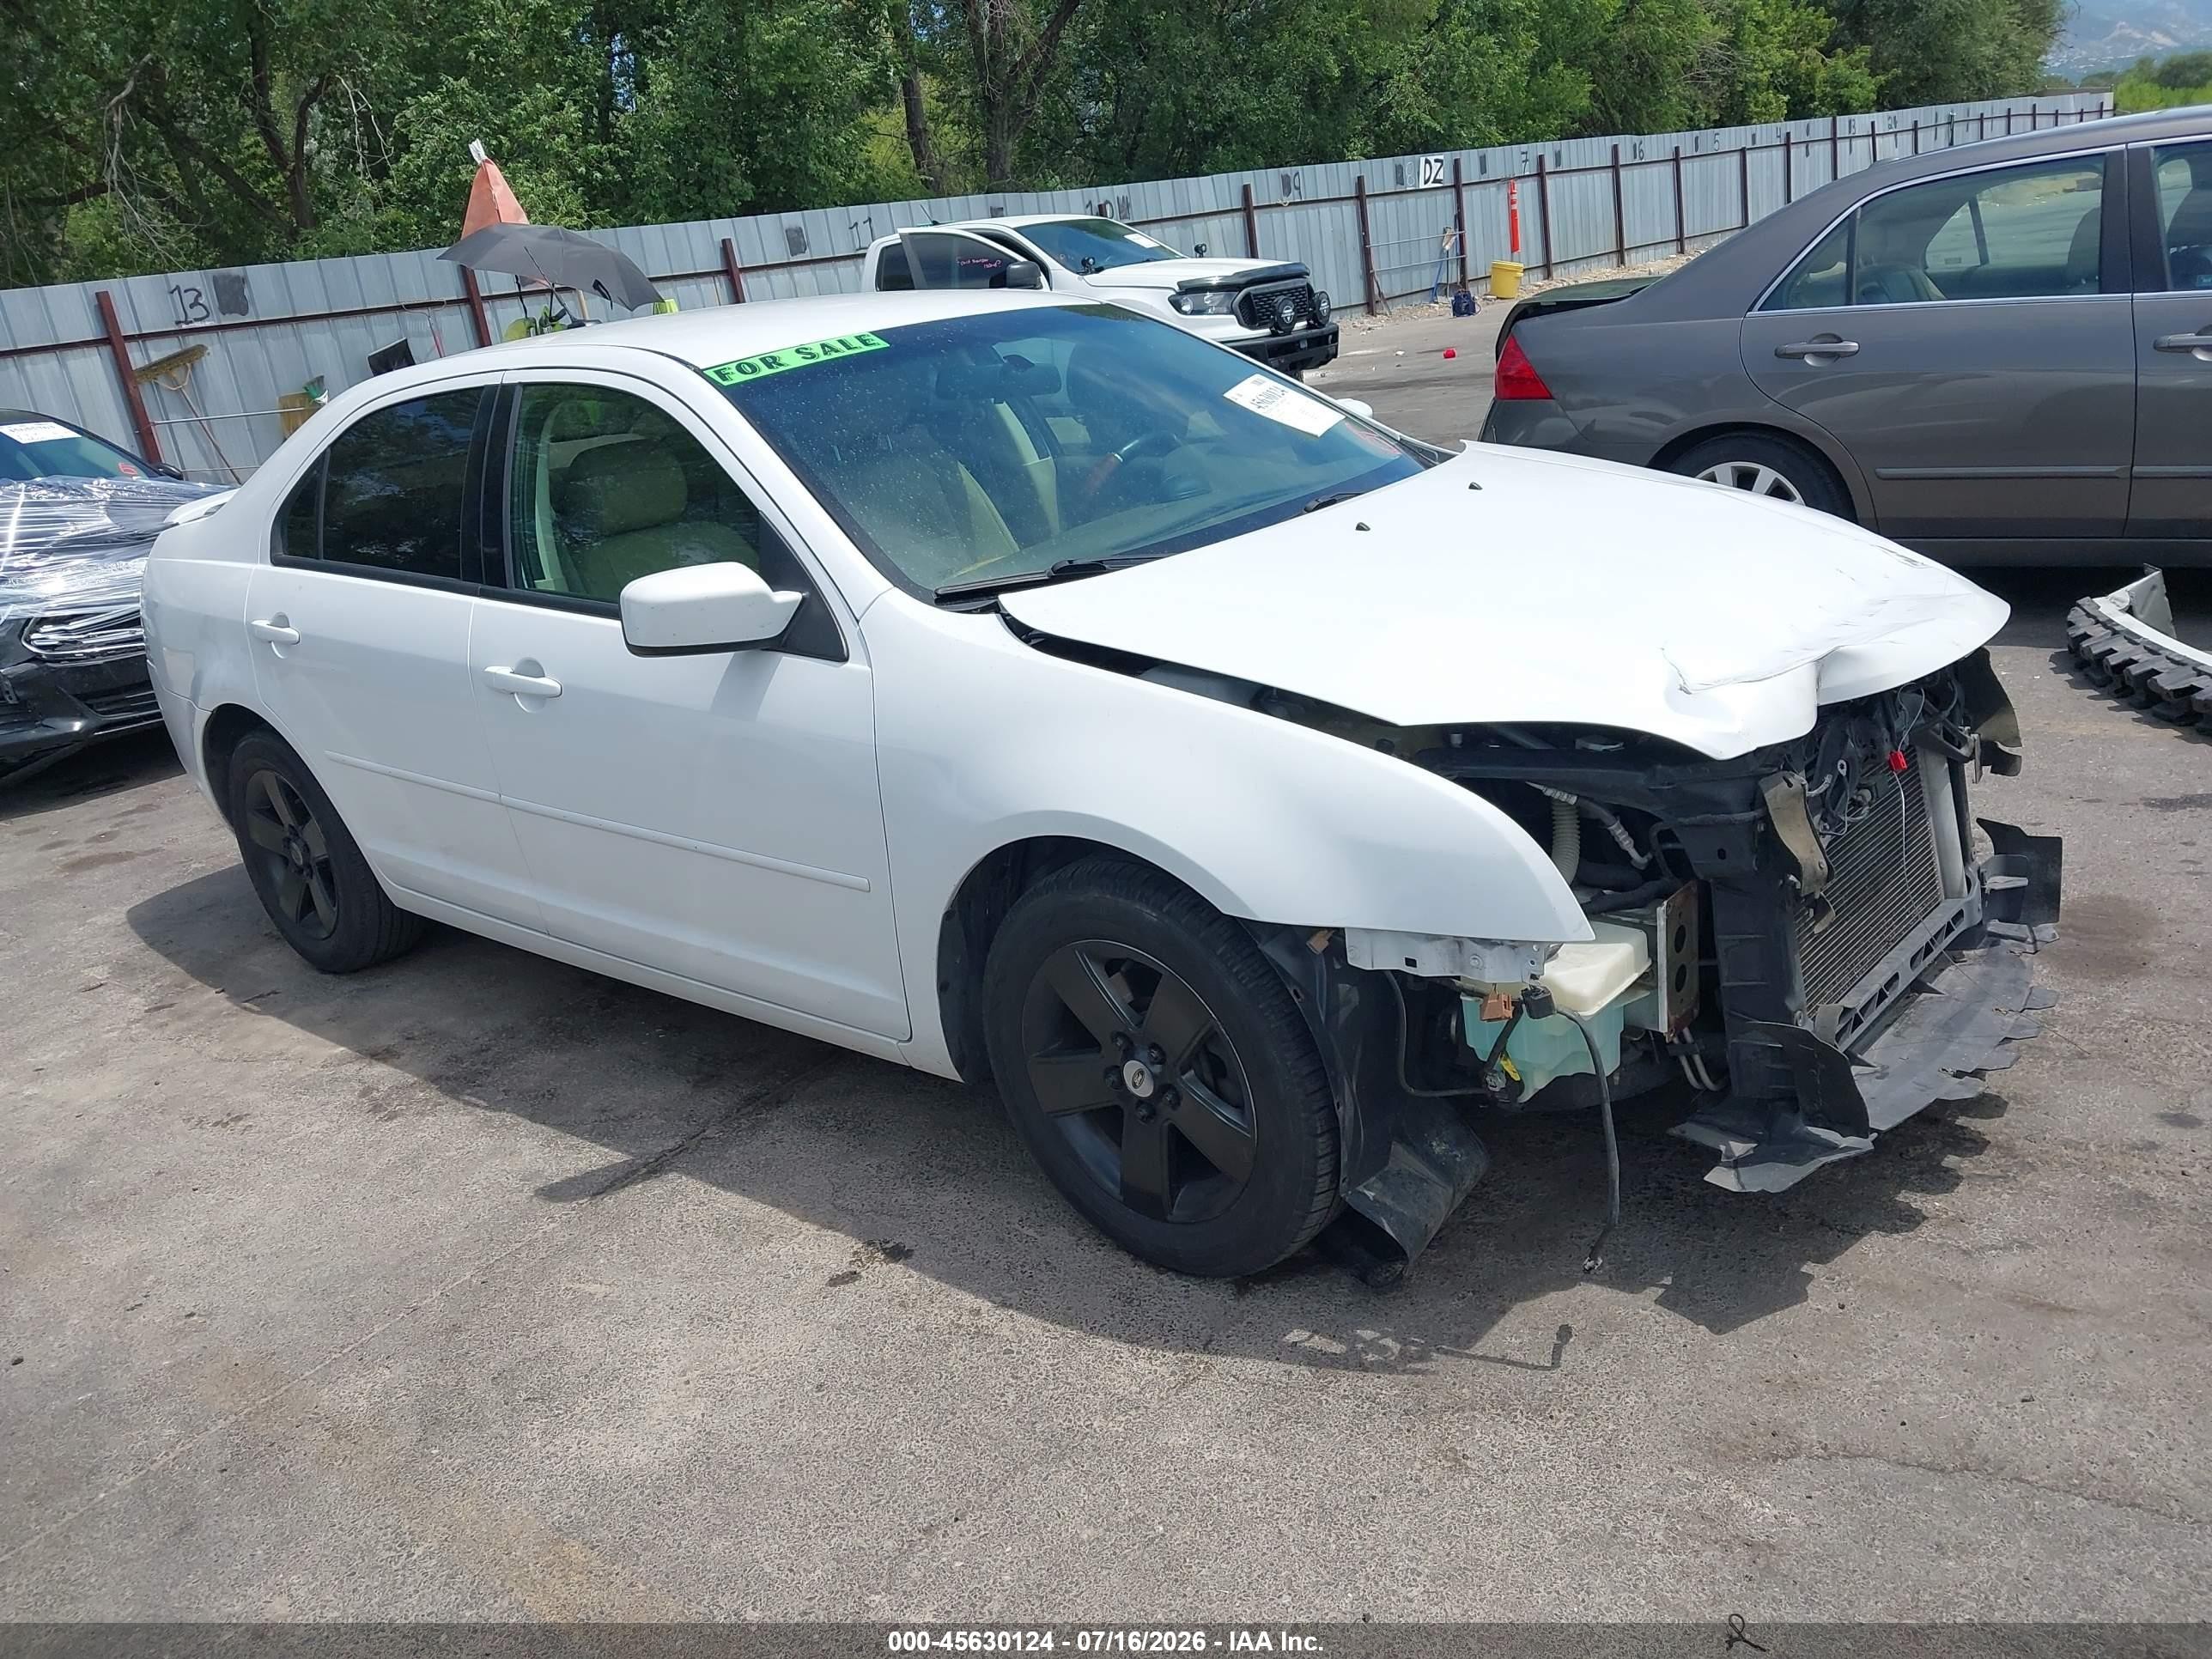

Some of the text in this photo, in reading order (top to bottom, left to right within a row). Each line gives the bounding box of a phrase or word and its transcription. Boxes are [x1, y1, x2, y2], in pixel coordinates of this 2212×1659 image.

[1713, 132, 1721, 151] 5
[1520, 150, 1529, 175] 7
[1293, 171, 1303, 200] 9
[848, 216, 874, 251] 11
[168, 284, 210, 325] 13
[713, 334, 881, 382] FOR SALE
